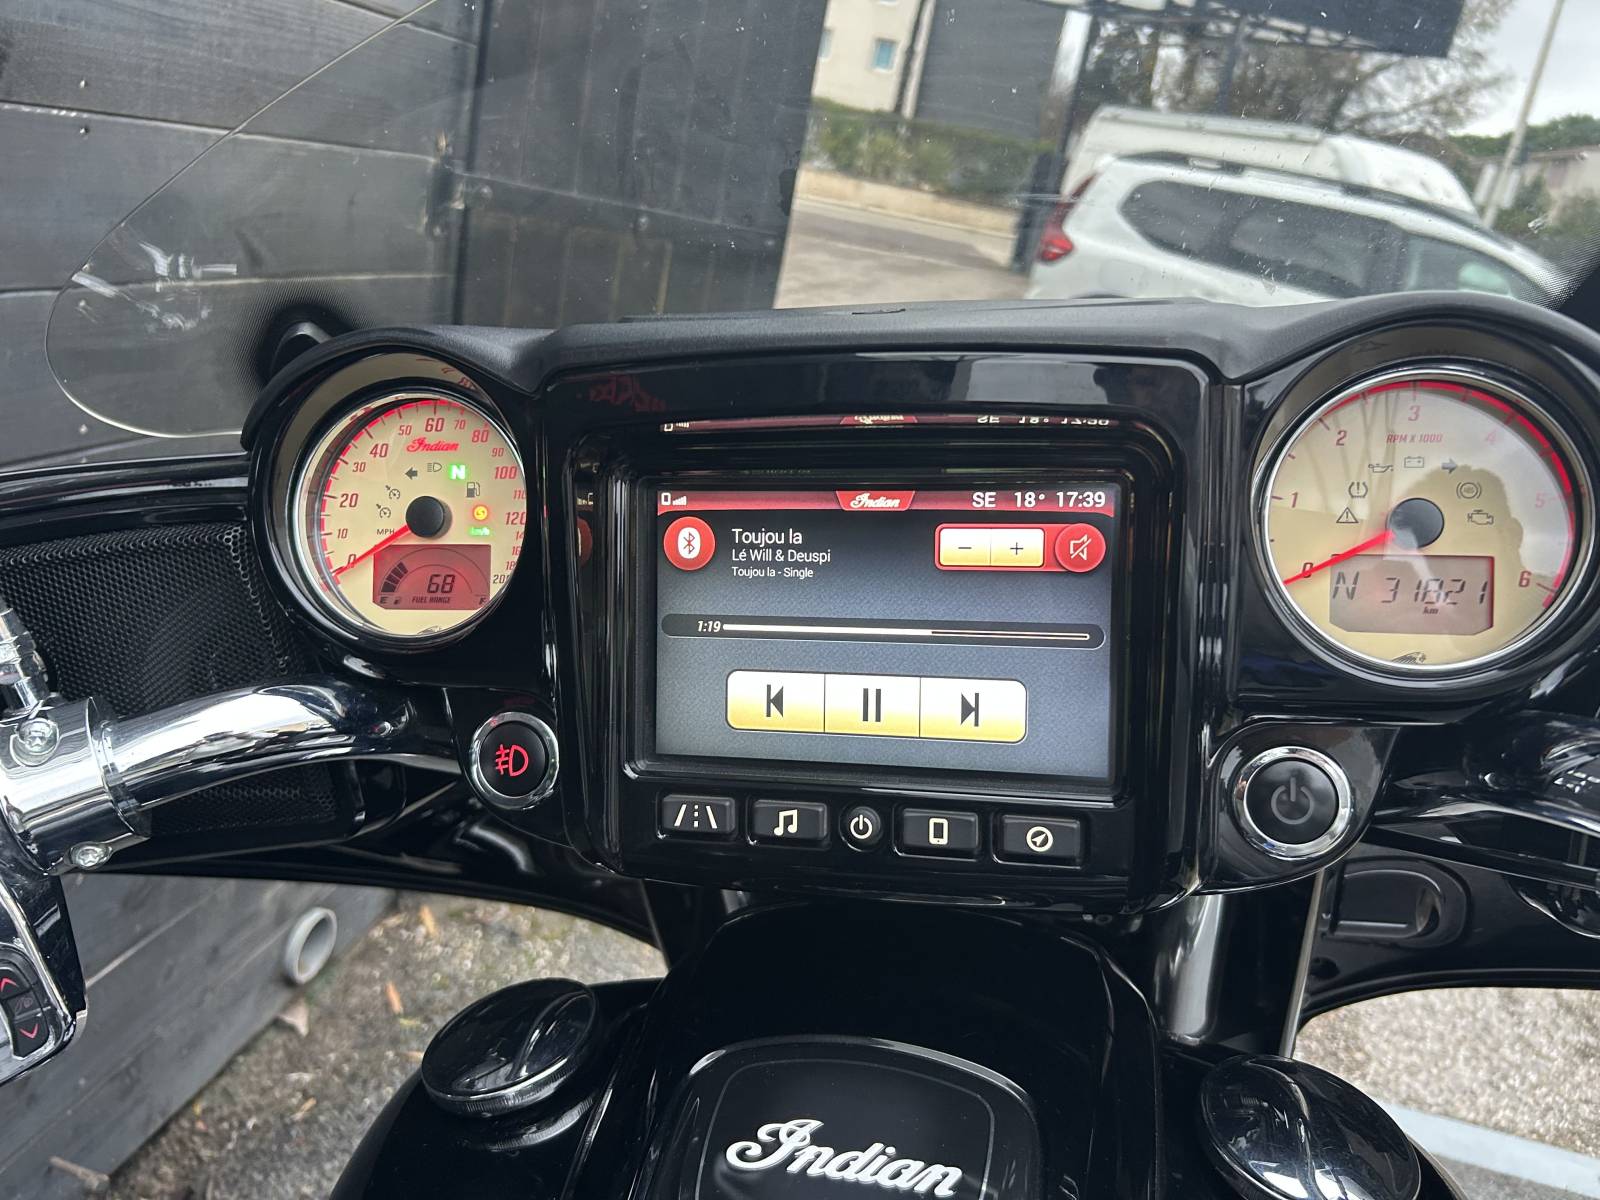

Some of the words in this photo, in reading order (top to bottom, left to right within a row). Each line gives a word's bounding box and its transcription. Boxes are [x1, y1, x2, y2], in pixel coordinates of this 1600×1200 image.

[1408, 404, 1421, 421] 3
[399, 425, 412, 436] 50
[425, 417, 445, 432] 60
[455, 420, 466, 430] 70
[472, 429, 489, 443] 80
[1336, 430, 1347, 446] 2
[1386, 434, 1408, 444] RPM
[1419, 434, 1443, 443] 1000
[369, 443, 389, 458] 40
[406, 437, 460, 453] Indian
[491, 447, 504, 457] 90
[352, 462, 366, 473] 30
[451, 465, 466, 480] N
[494, 466, 518, 480] 100
[339, 493, 359, 508] 20
[850, 493, 901, 509] Indian
[972, 491, 997, 508] SE
[1014, 491, 1045, 508] 18°
[1056, 491, 1106, 508] 17:39
[1291, 492, 1299, 508] 1
[1535, 492, 1547, 508] 5
[337, 528, 348, 539] 10
[731, 528, 785, 547] Toujou
[788, 528, 803, 544] la
[732, 548, 747, 561] Lé
[749, 548, 772, 562] Will
[774, 549, 785, 562] &
[787, 549, 831, 565] Deuspi
[492, 575, 510, 585] 20
[731, 566, 765, 578] Toujou
[766, 567, 775, 577] la
[783, 567, 814, 579] Single
[1518, 571, 1532, 588] 6
[427, 574, 456, 594] 68
[1332, 571, 1360, 600] N
[1381, 577, 1489, 606] 31821
[412, 596, 428, 605] FUEL
[429, 596, 451, 605] RANGE
[1422, 606, 1439, 615] km
[697, 620, 721, 633] 1:19
[726, 1118, 962, 1198] Indian
